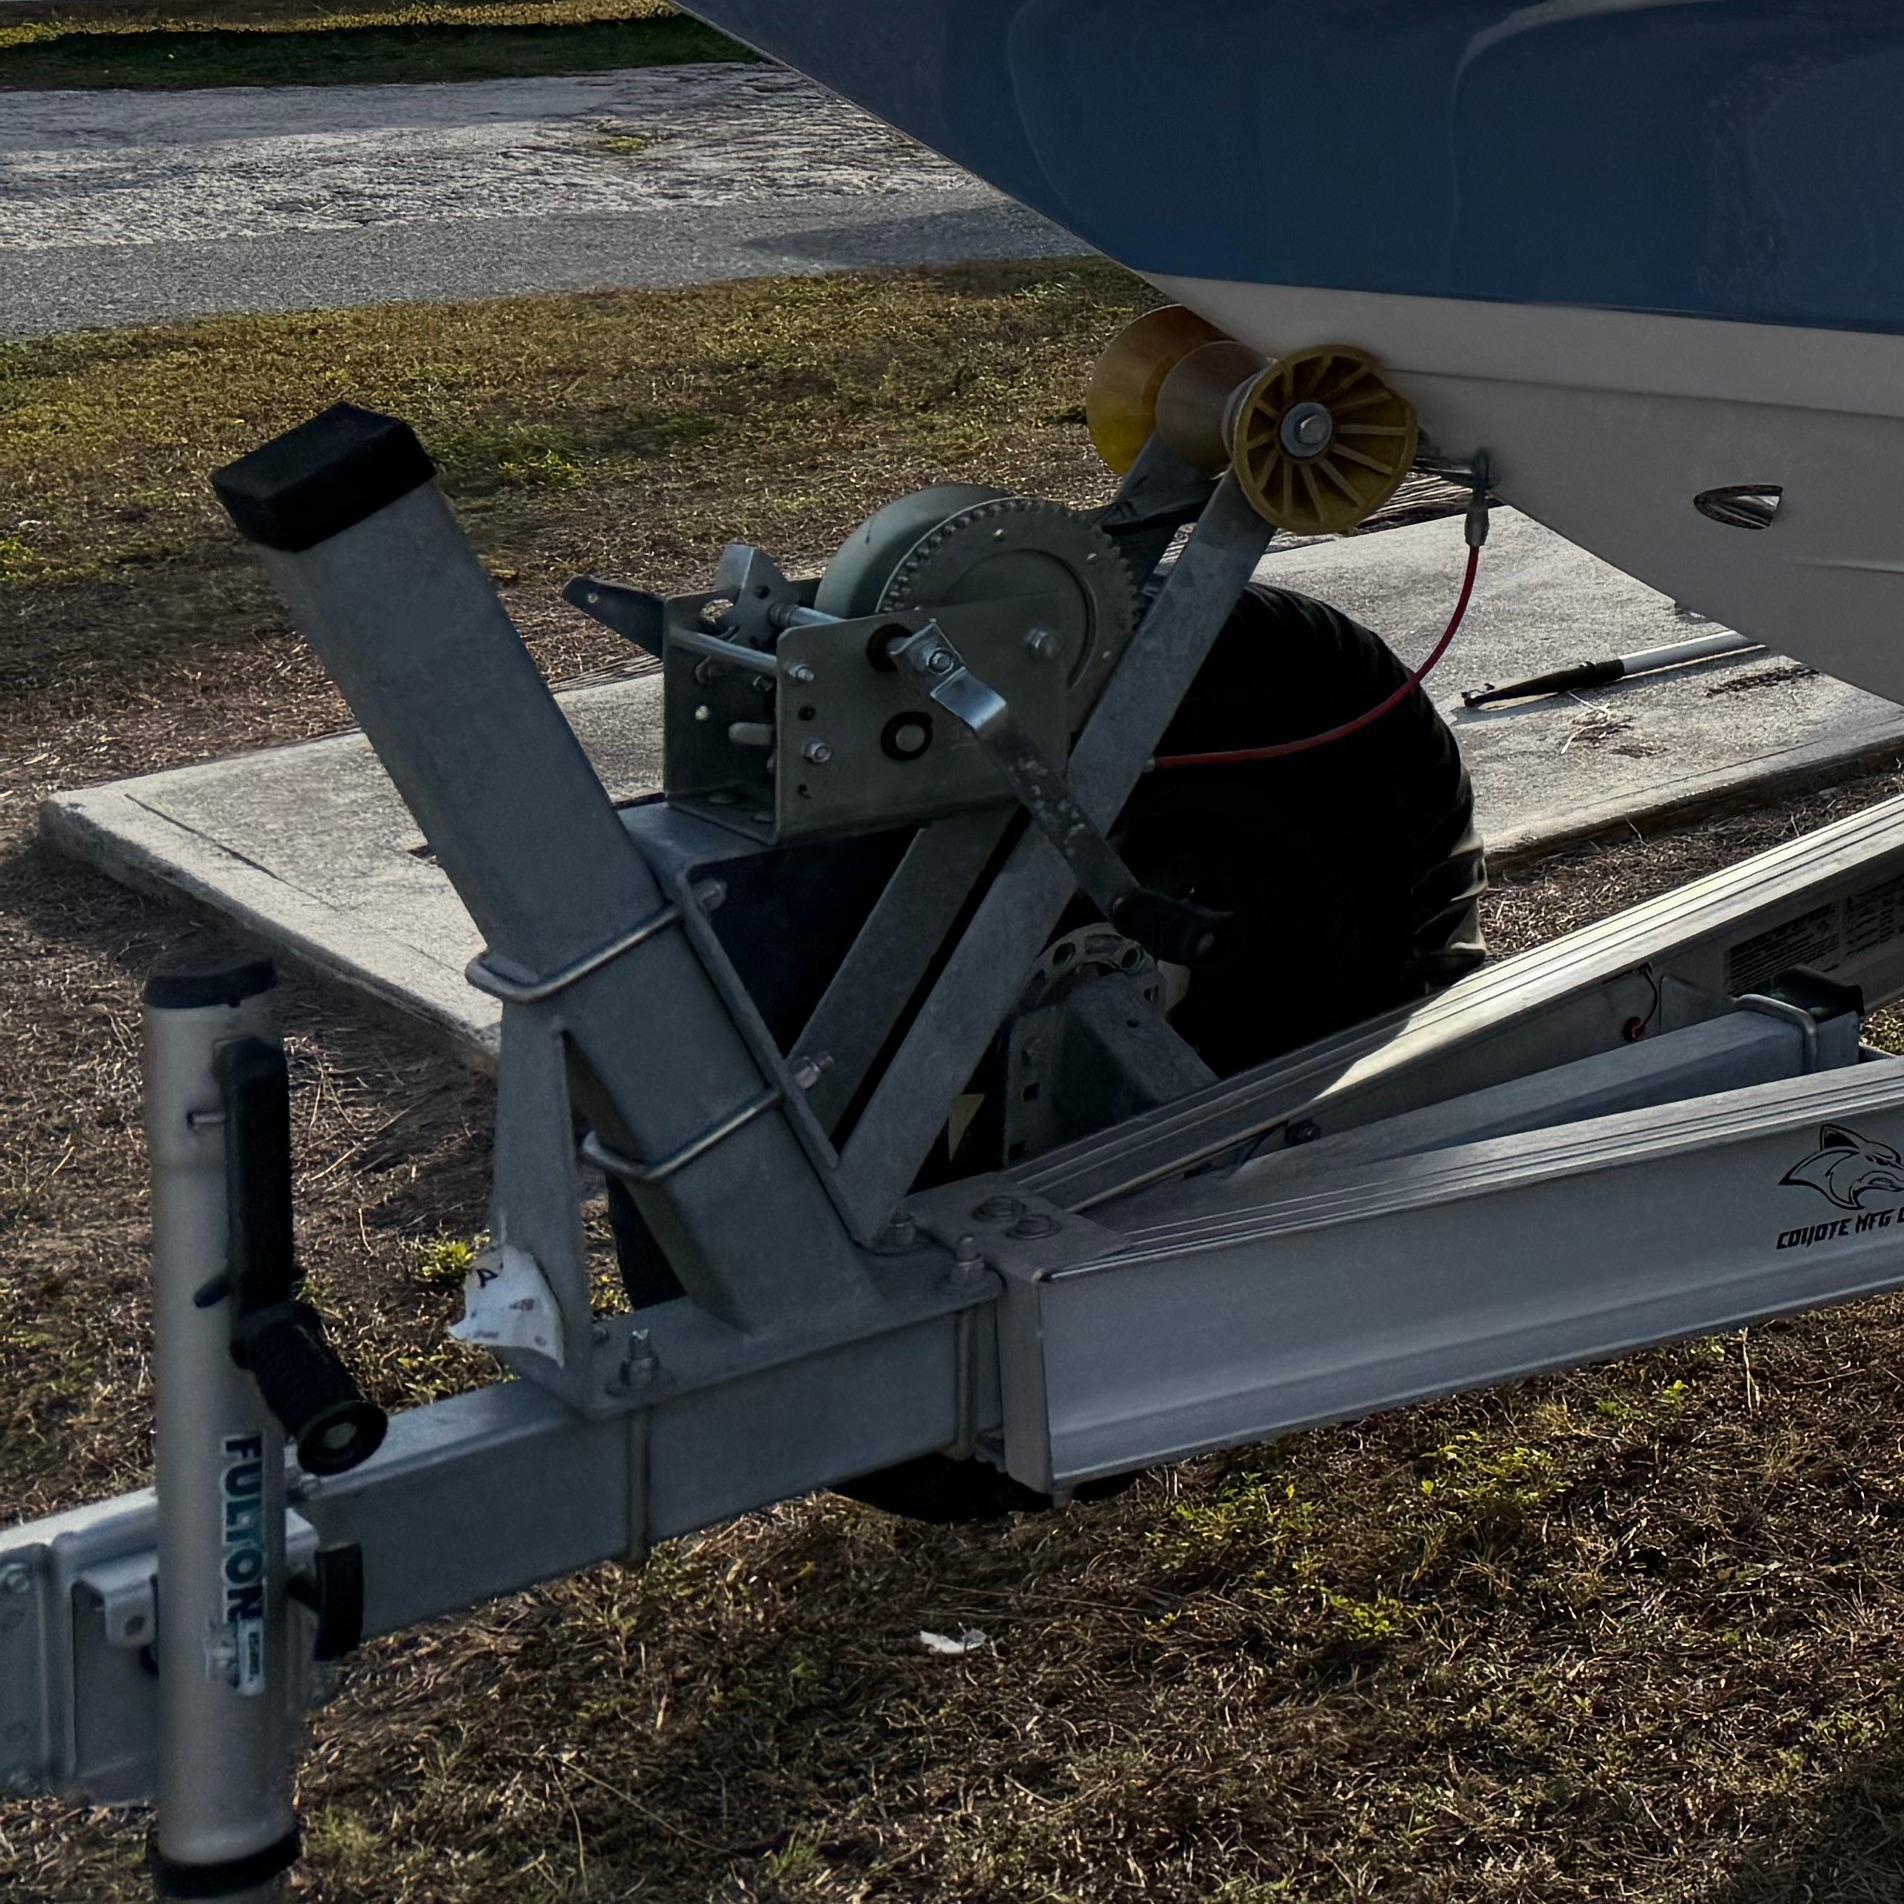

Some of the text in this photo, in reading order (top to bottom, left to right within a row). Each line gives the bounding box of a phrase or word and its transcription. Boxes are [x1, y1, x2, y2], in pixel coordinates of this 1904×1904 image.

[1776, 1218, 1853, 1250] COYOTE
[1855, 1208, 1892, 1236] MFG
[223, 1434, 265, 1624] FULTON
